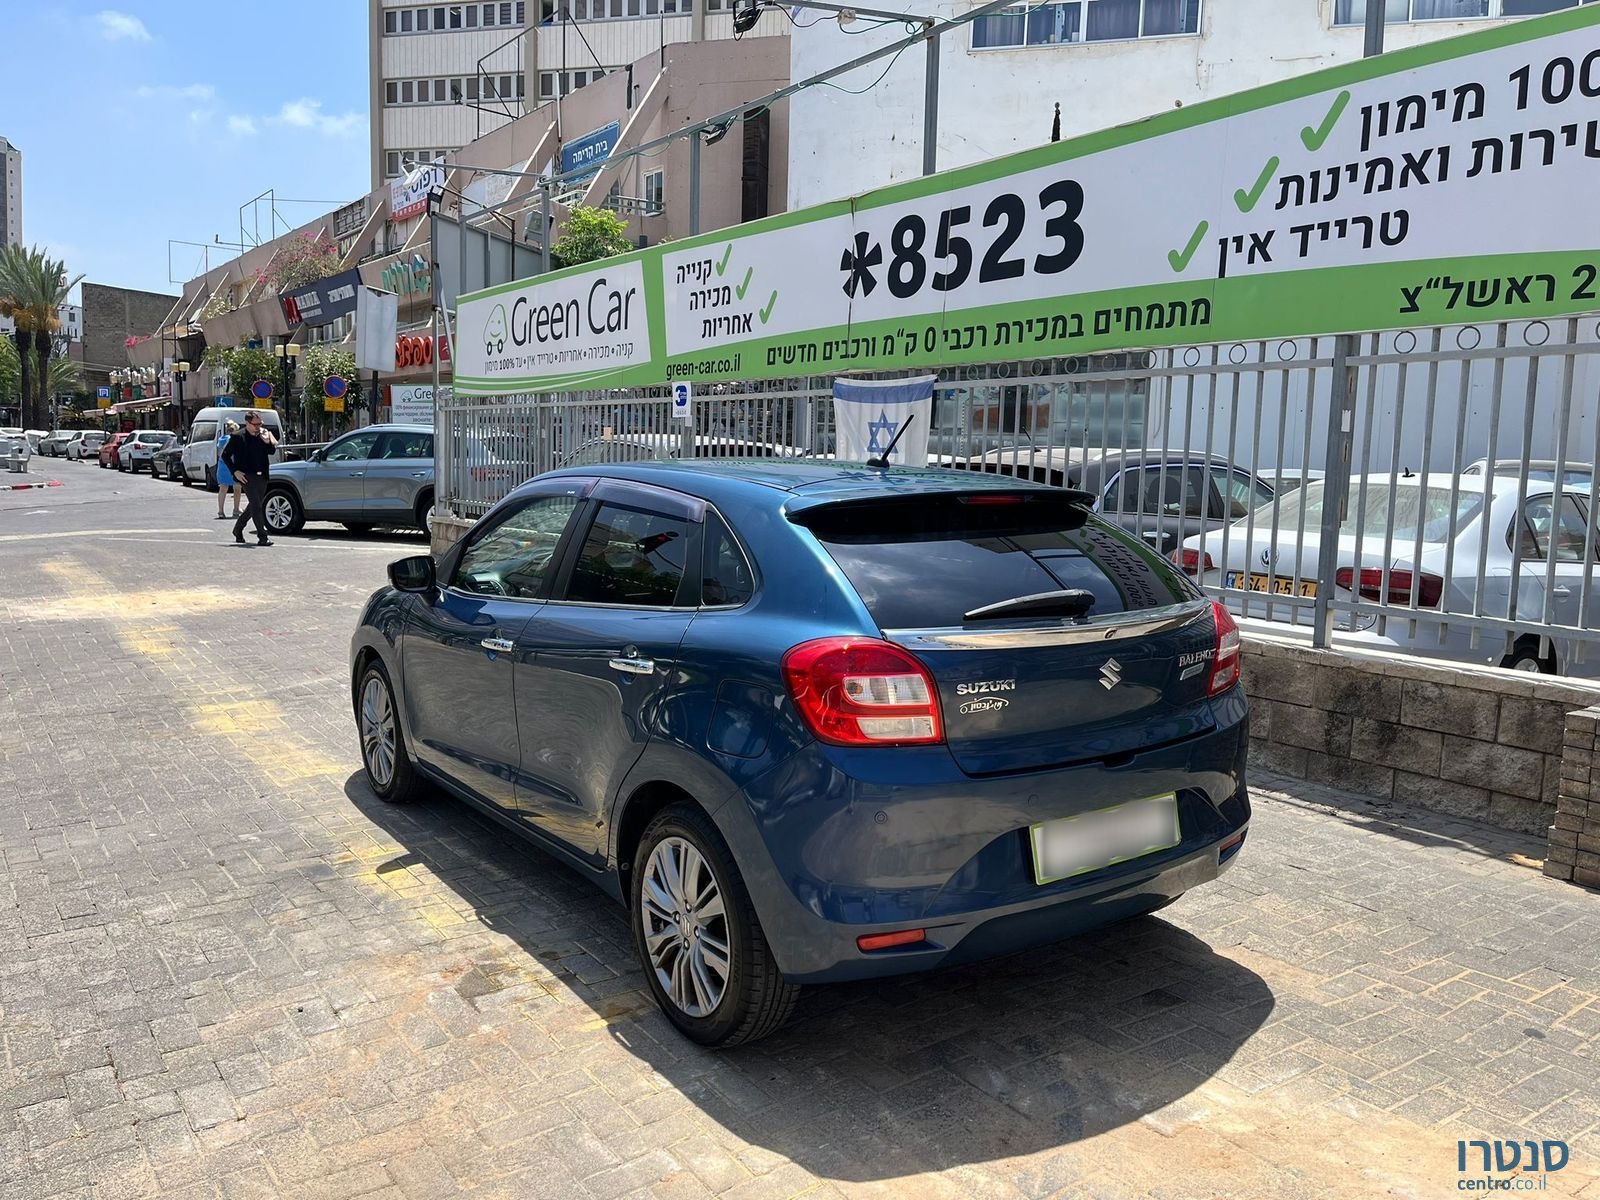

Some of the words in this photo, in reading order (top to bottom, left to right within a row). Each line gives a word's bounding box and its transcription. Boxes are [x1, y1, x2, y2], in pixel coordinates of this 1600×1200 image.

[1360, 82, 1485, 152] מימון
[595, 140, 608, 154] בית
[1274, 145, 1451, 210] ואמינות
[1289, 209, 1410, 258] טרייד
[1218, 230, 1276, 279] אין
[676, 258, 712, 286] קנייה
[689, 285, 732, 311] מכירה
[511, 296, 580, 347] Green
[587, 278, 636, 335] Car
[701, 312, 753, 339] אחריות
[1093, 297, 1211, 336] מתמחים
[924, 326, 936, 353] 0
[942, 325, 988, 350] רכבי
[993, 313, 1085, 346] במכירת
[558, 349, 583, 363] אחריות
[587, 345, 610, 360] מכירה
[615, 342, 634, 360] קניה
[766, 343, 817, 366] חדשים
[822, 336, 876, 361] ורכבים
[499, 358, 515, 370] 100%
[666, 353, 741, 381] green-car.co.il
[956, 678, 1016, 695] SUZUKI
